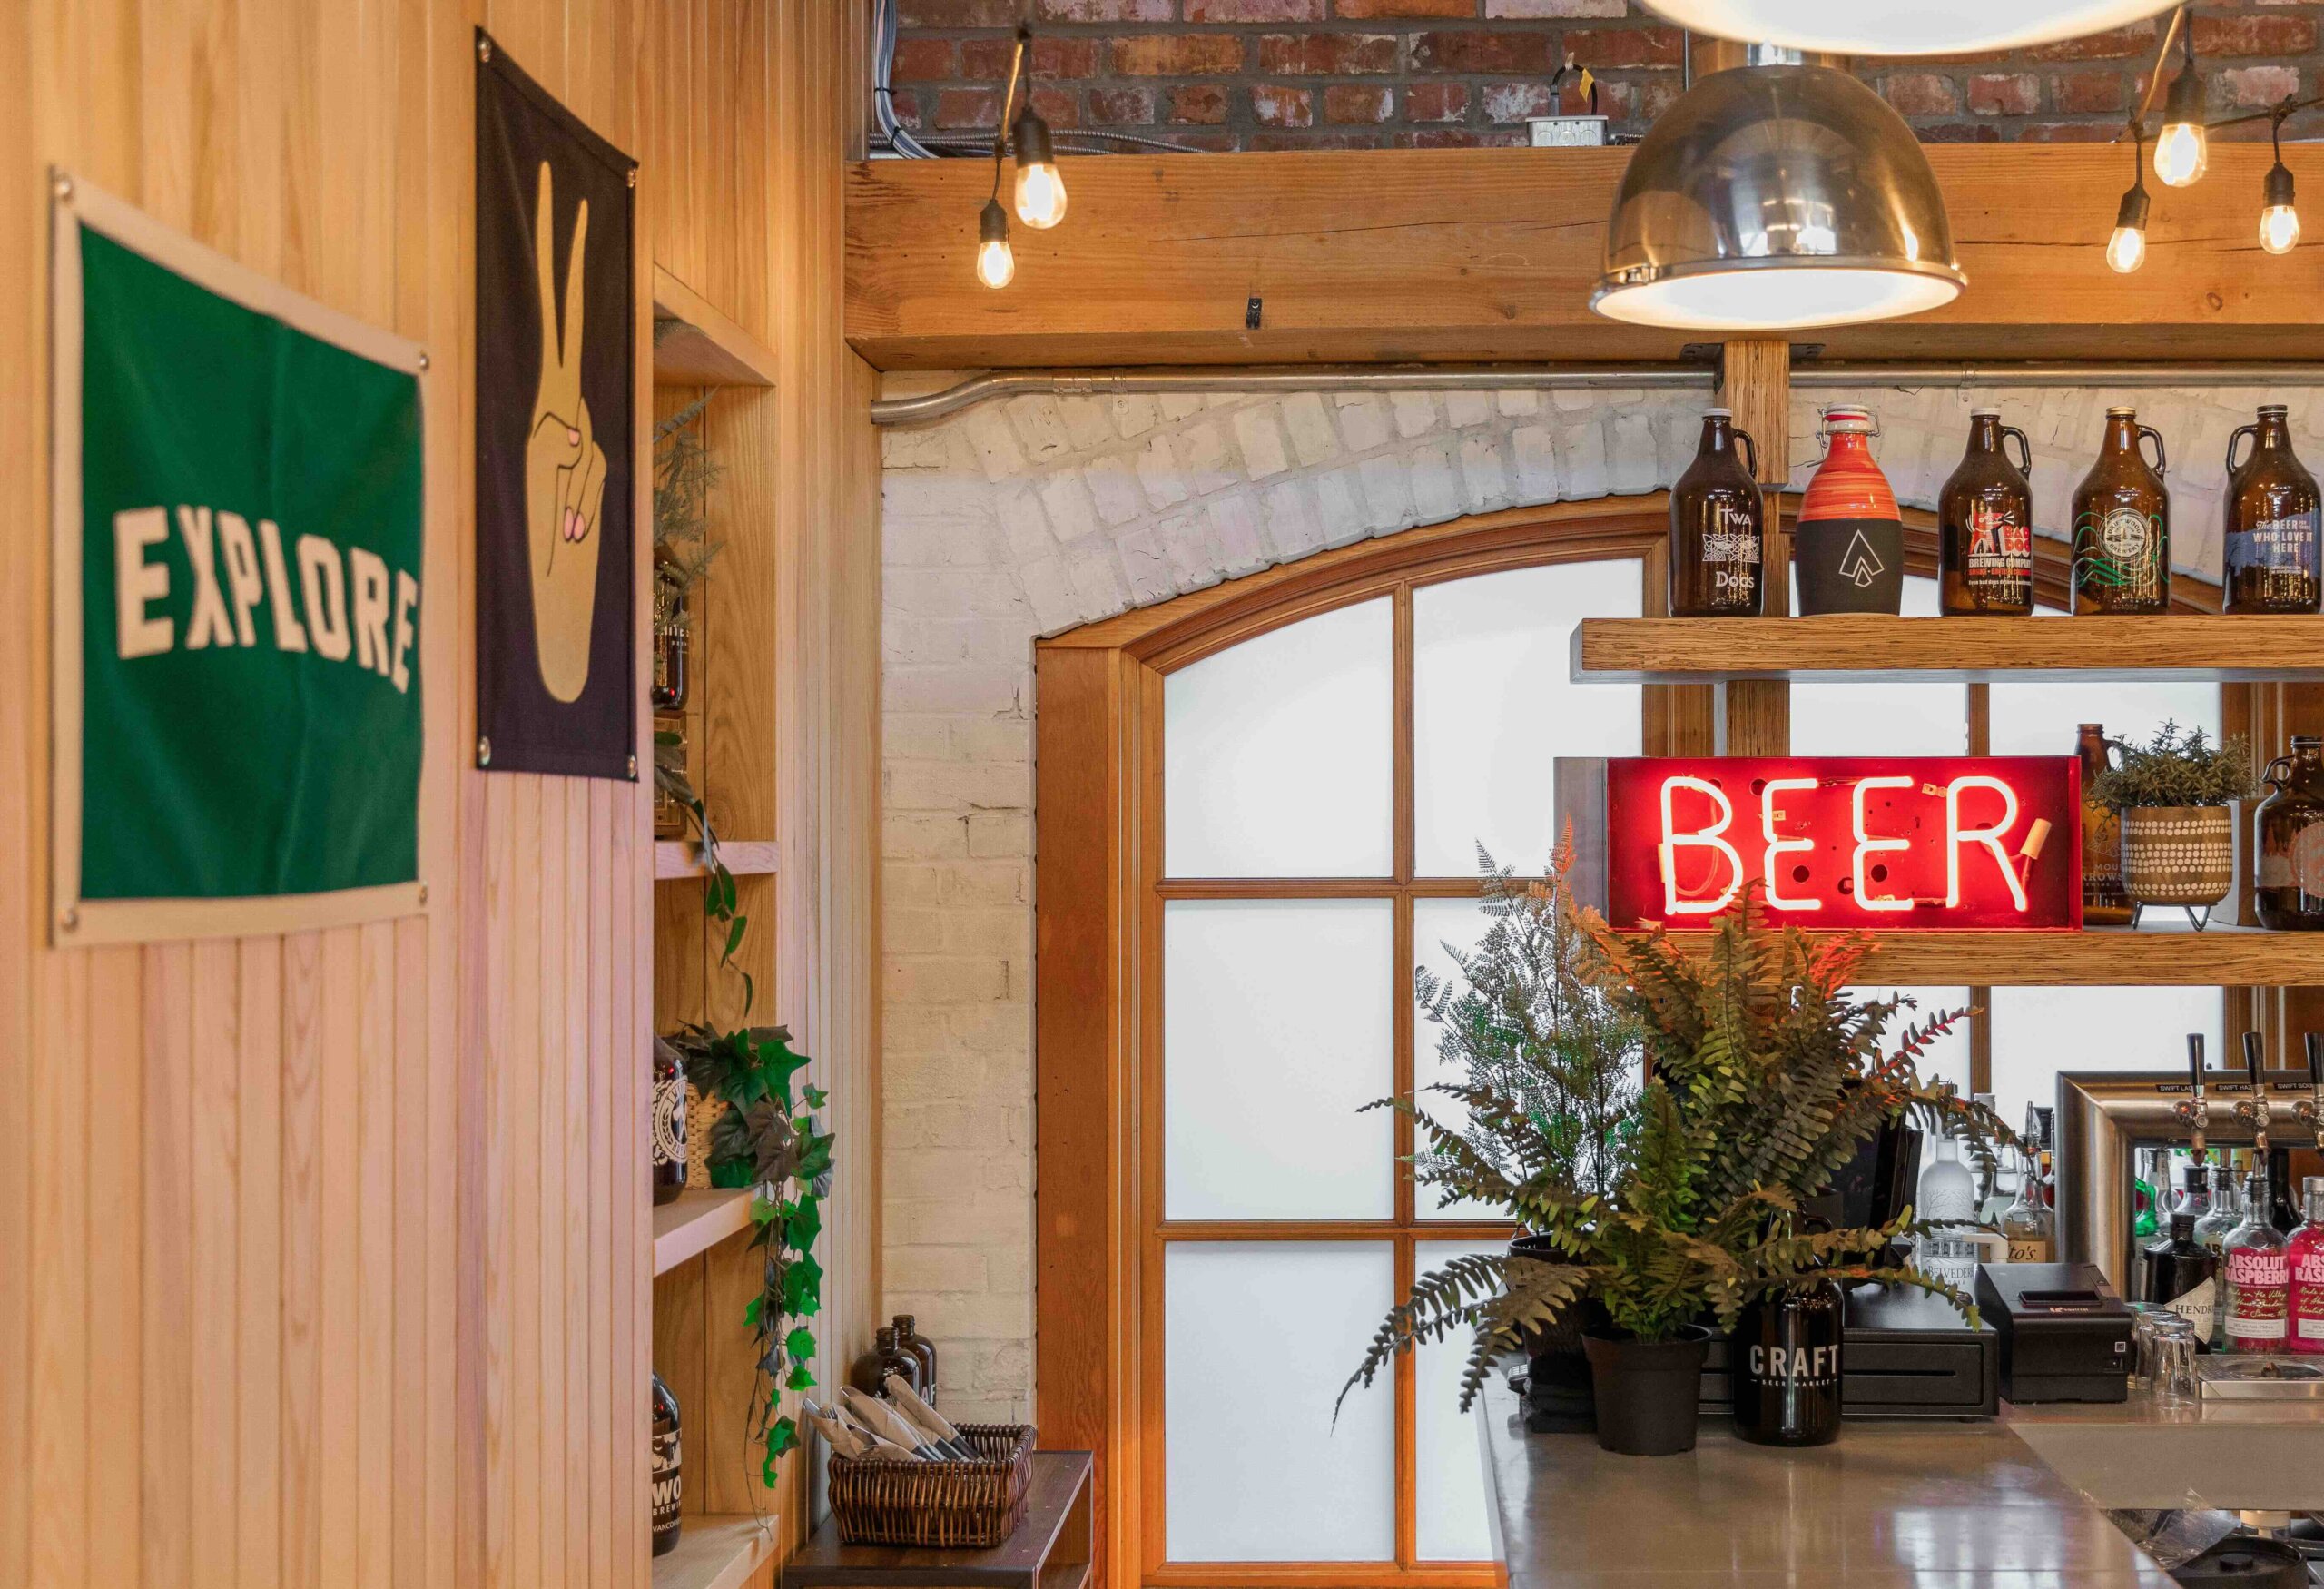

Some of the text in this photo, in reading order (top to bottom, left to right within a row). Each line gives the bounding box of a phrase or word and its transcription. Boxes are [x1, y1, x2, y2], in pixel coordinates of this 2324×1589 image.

[2107, 518, 2142, 534] DRIFWOOD
[2272, 519, 2298, 530] BEER
[2003, 526, 2030, 538] BAD
[2253, 532, 2278, 542] WHO
[2281, 531, 2304, 542] LOVE
[2109, 543, 2141, 554] BREERY
[2273, 543, 2299, 553] HERE
[1968, 558, 2004, 568] BREWING
[113, 503, 419, 694] EXPLORE
[1659, 775, 2029, 915] BEER
[2229, 1254, 2287, 1270] ABSOLUT
[1750, 1345, 1838, 1377] CRAFT
[1794, 1378, 1830, 1387] MARKET
